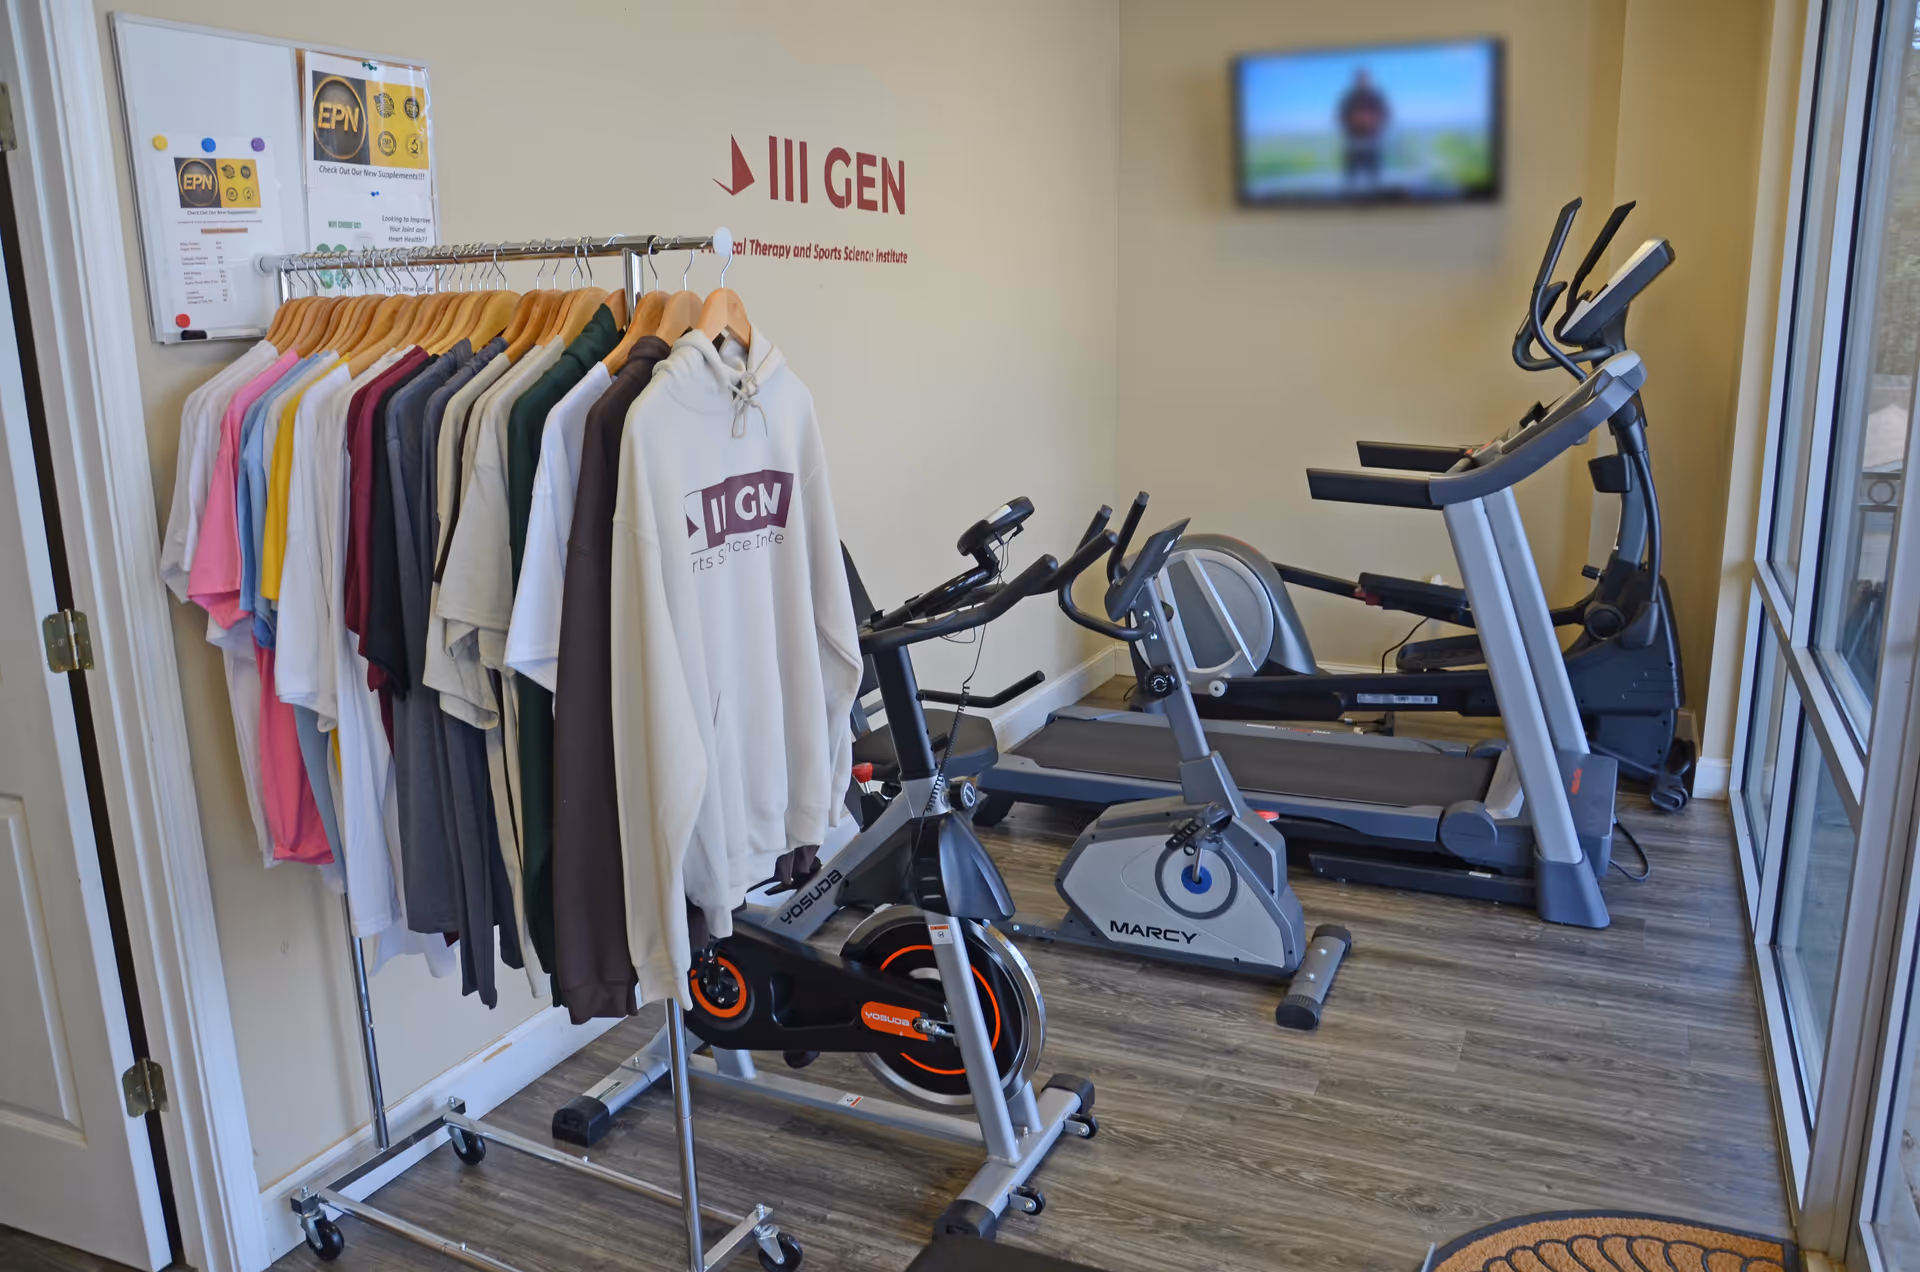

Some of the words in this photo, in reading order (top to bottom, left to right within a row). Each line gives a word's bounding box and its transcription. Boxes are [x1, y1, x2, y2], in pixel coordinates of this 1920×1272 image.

[317, 101, 359, 133] EPN
[183, 174, 213, 190] EPN
[318, 165, 337, 174] Check
[339, 166, 350, 175] Out
[351, 168, 362, 176] Our
[363, 169, 378, 177] New
[378, 170, 425, 181] Supplements!!!
[824, 147, 905, 215] GEN
[382, 215, 402, 223] Looking
[749, 239, 791, 259] Therapy
[793, 243, 811, 259] and
[814, 243, 842, 262] Sports
[843, 246, 874, 262] Science
[876, 248, 908, 264] Institute
[1110, 920, 1198, 944] MARCY
